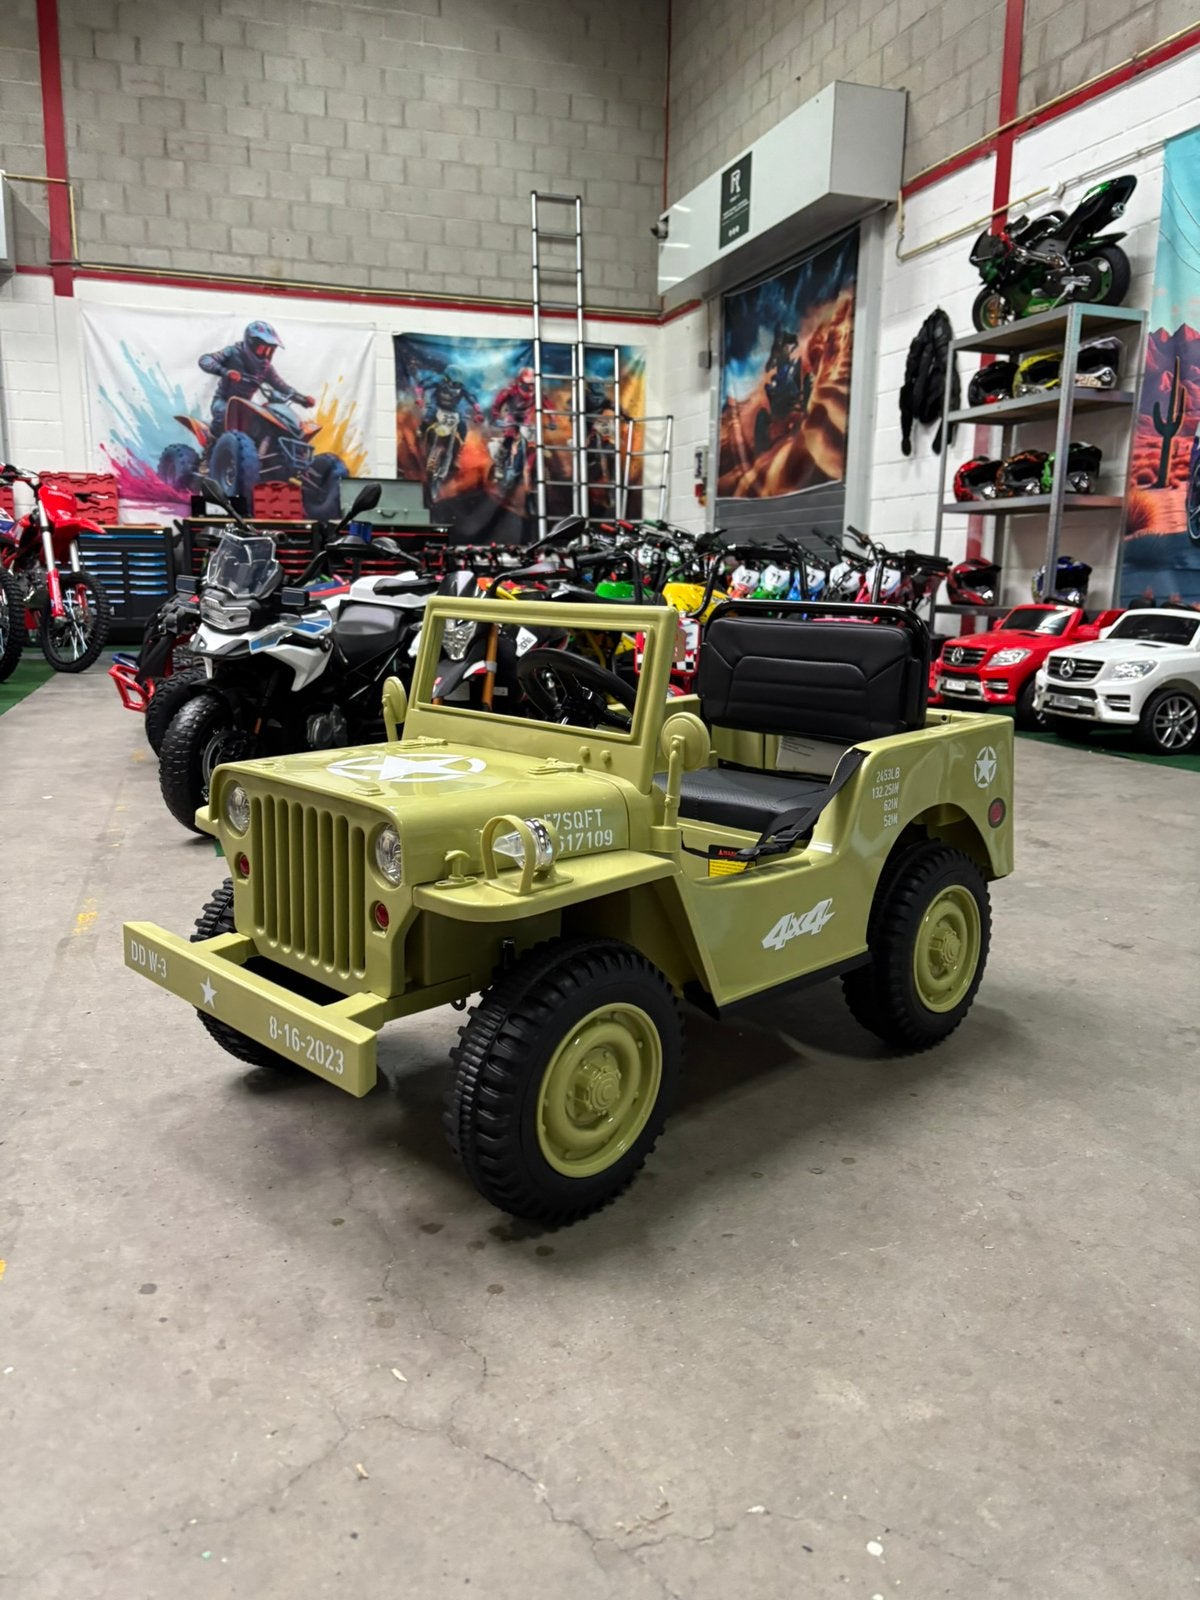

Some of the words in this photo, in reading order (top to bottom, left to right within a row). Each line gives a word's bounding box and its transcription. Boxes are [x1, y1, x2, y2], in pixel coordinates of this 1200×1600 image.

[876, 767, 900, 783] 2453LB
[131, 939, 146, 967] DD
[148, 950, 168, 979] W-3
[268, 1014, 345, 1076] 8-16-2023
